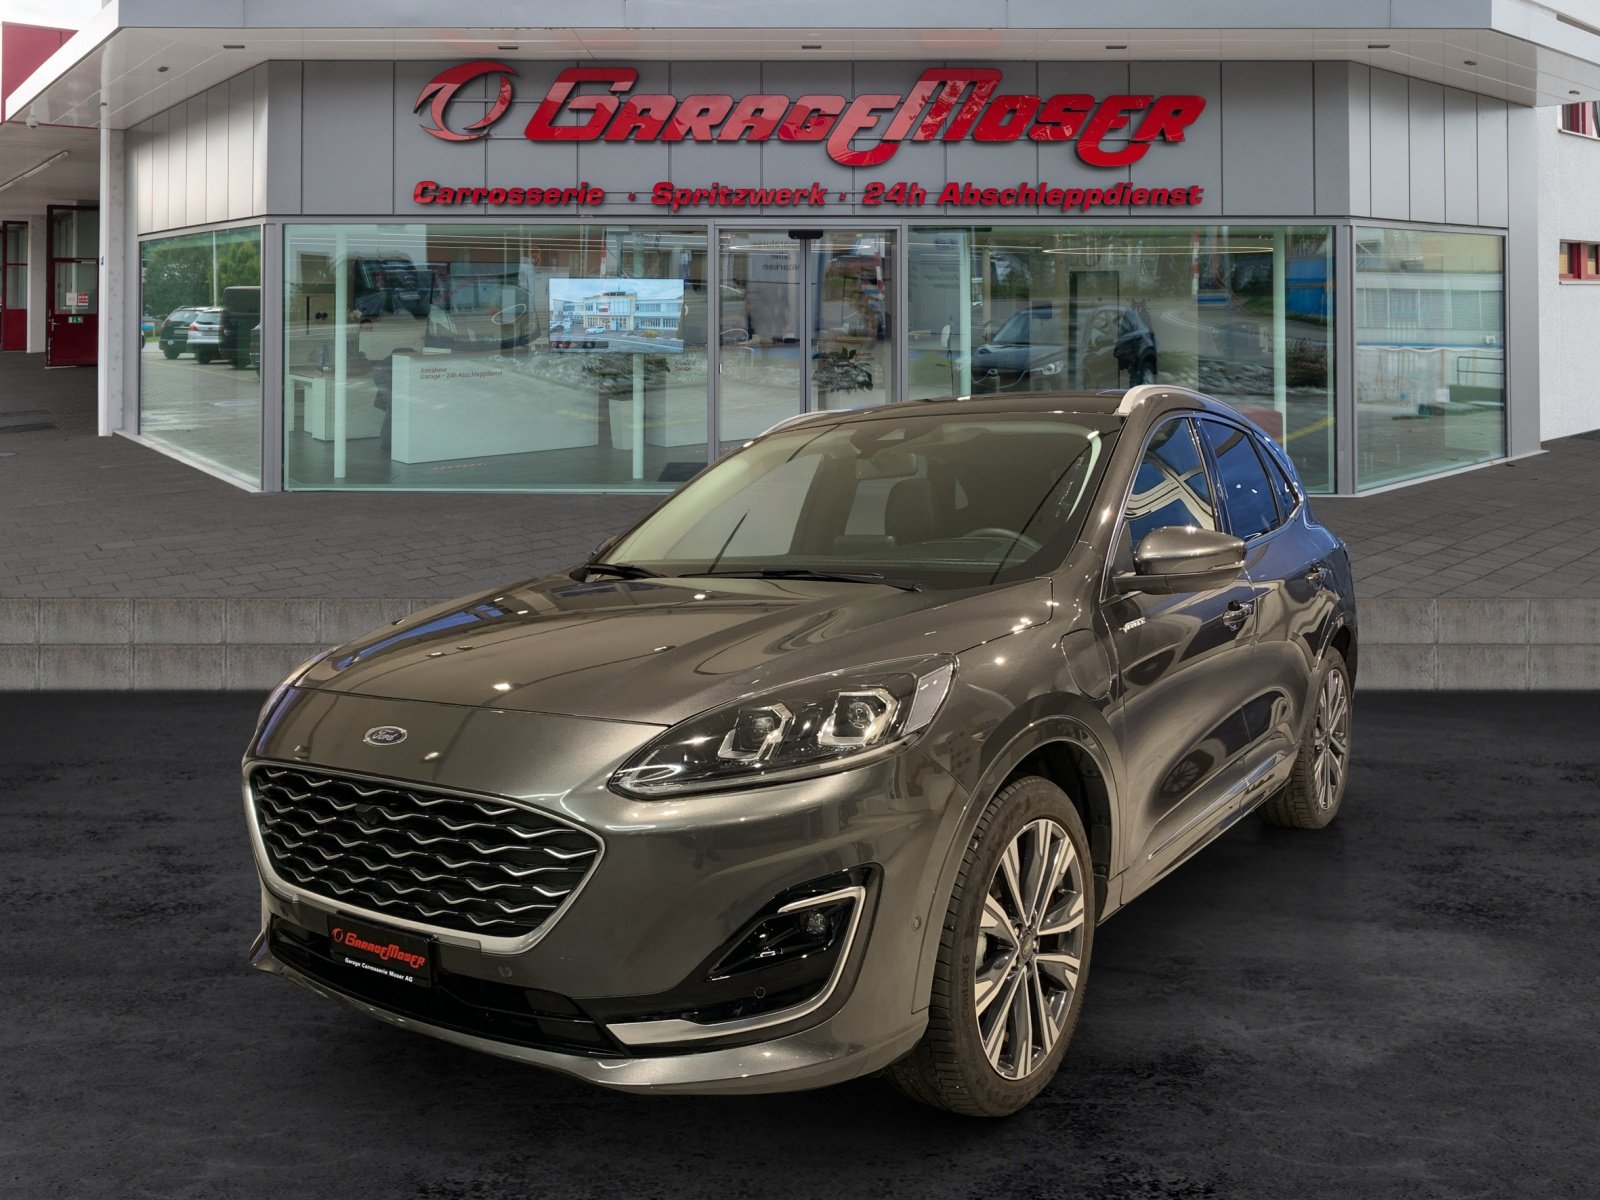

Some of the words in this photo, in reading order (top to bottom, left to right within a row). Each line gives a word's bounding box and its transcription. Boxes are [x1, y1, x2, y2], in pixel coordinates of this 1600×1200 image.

[413, 180, 605, 206] Carrosserie
[650, 181, 826, 212] Spritzwerk
[862, 181, 927, 206] 24h
[937, 181, 1204, 212] Abschleppdienst
[344, 957, 361, 968] Garage
[361, 962, 388, 976] Carrosserie
[389, 970, 405, 980] Moser
[404, 975, 413, 983] AG
